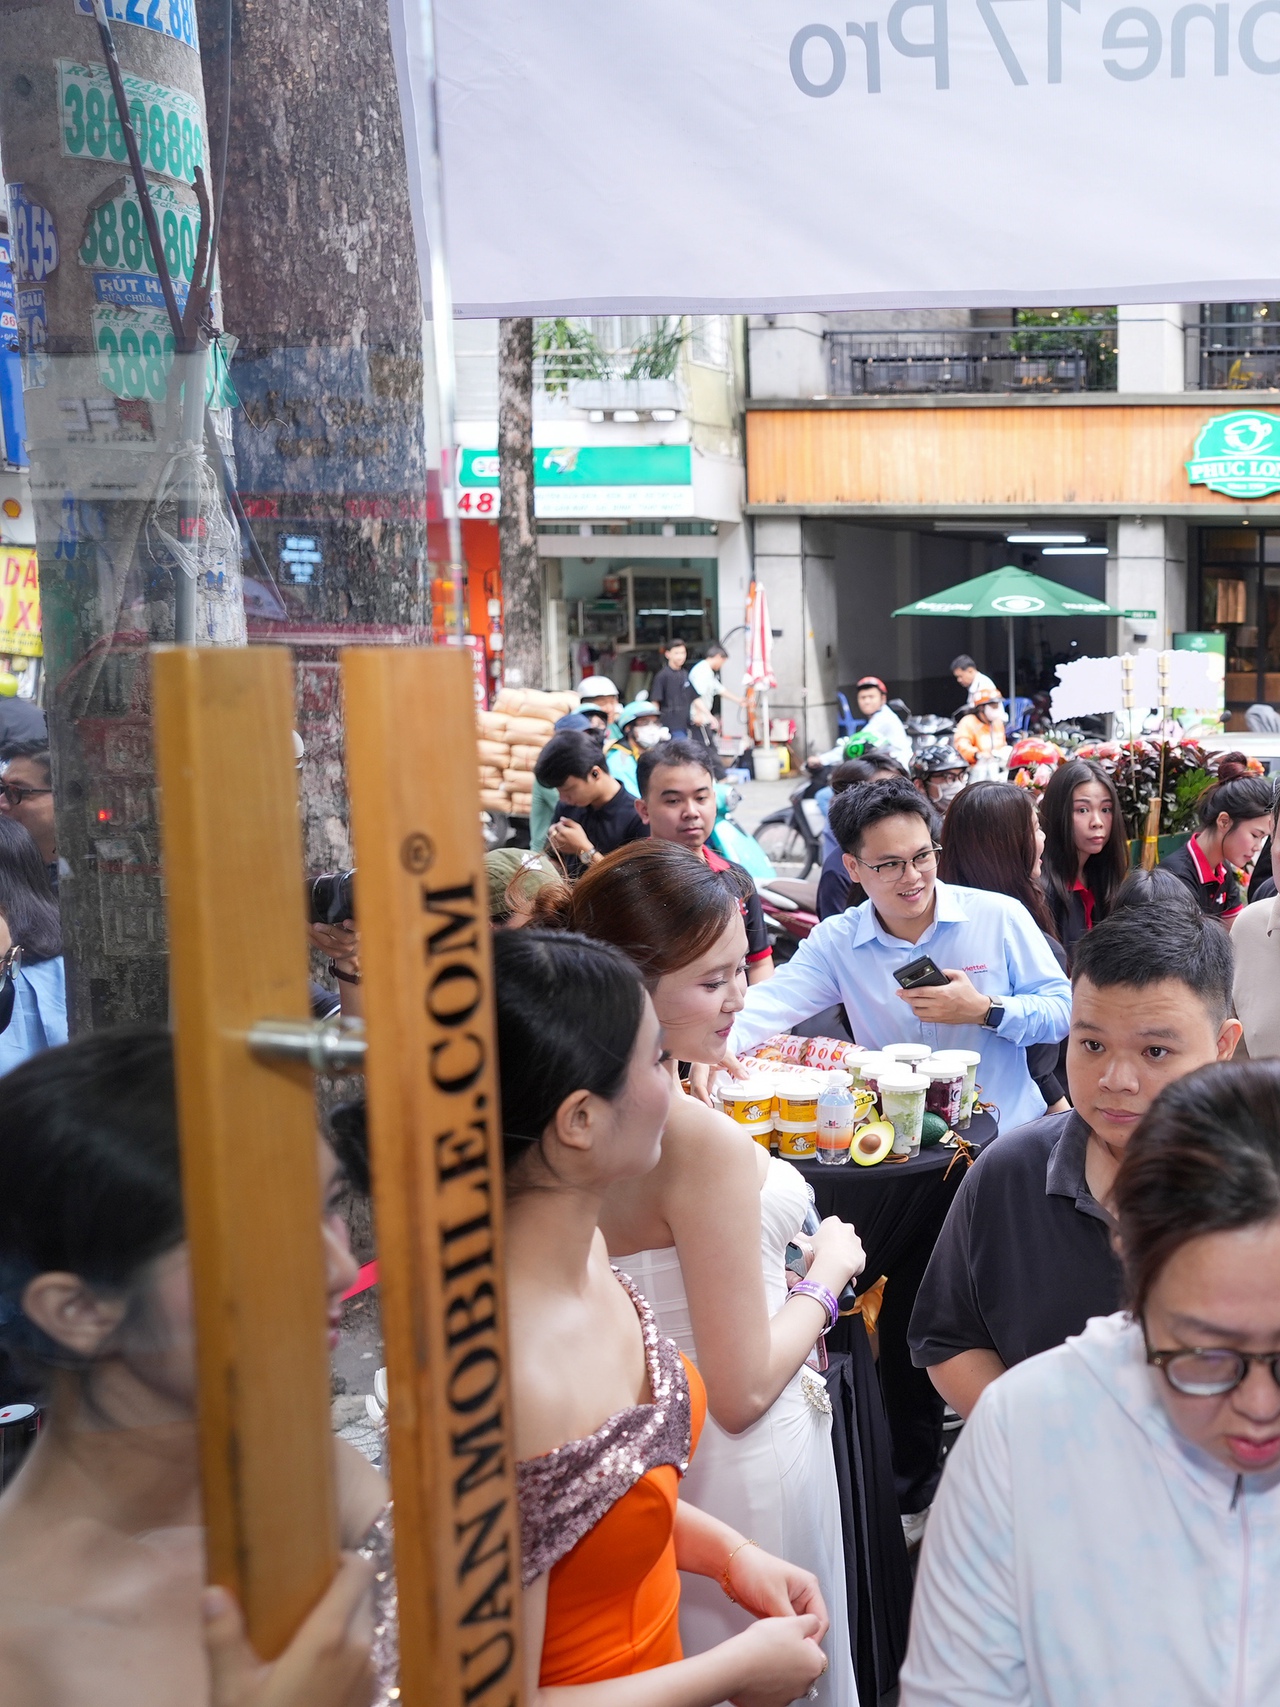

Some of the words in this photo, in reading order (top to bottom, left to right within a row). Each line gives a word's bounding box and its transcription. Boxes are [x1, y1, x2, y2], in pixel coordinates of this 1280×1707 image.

[1190, 461, 1245, 480] PHUC
[458, 493, 494, 513] 48
[421, 873, 518, 1707] UANMOBILE.COM
